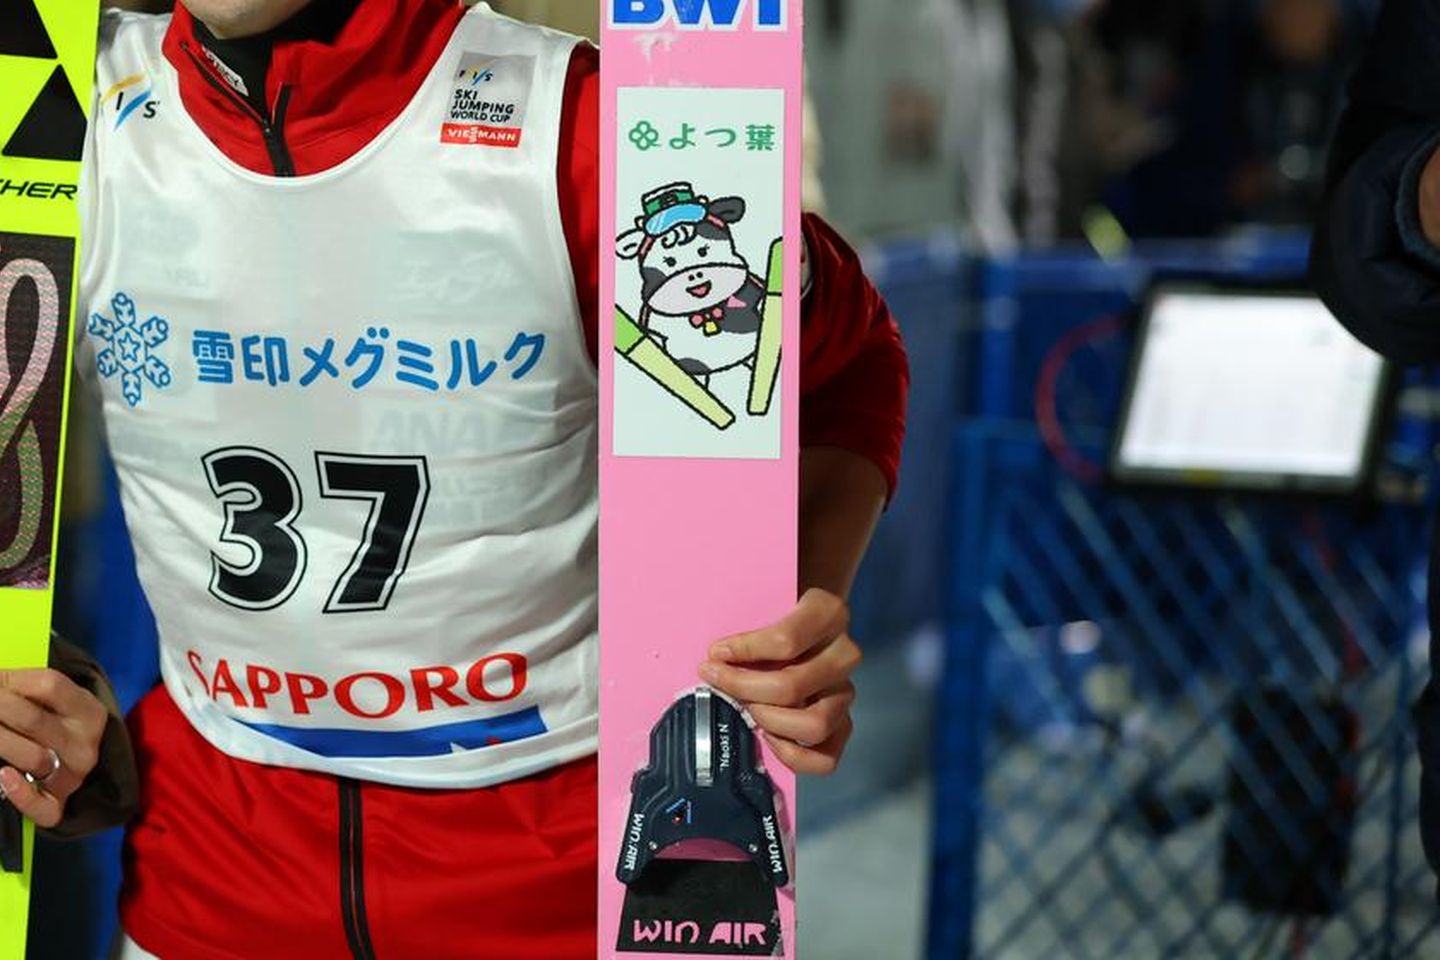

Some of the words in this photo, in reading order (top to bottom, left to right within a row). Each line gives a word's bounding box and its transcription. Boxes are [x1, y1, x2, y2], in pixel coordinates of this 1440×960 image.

[452, 101, 514, 115] JUMPING
[454, 89, 478, 100] SKI
[450, 111, 488, 121] WORLD
[490, 115, 511, 123] CUP
[668, 123, 776, 151] よつ葉
[192, 326, 546, 391] 雪印メグミルク
[201, 445, 430, 614] 37
[187, 649, 527, 719] SAPPORO
[633, 919, 700, 944] WIN
[709, 922, 767, 945] AIR
